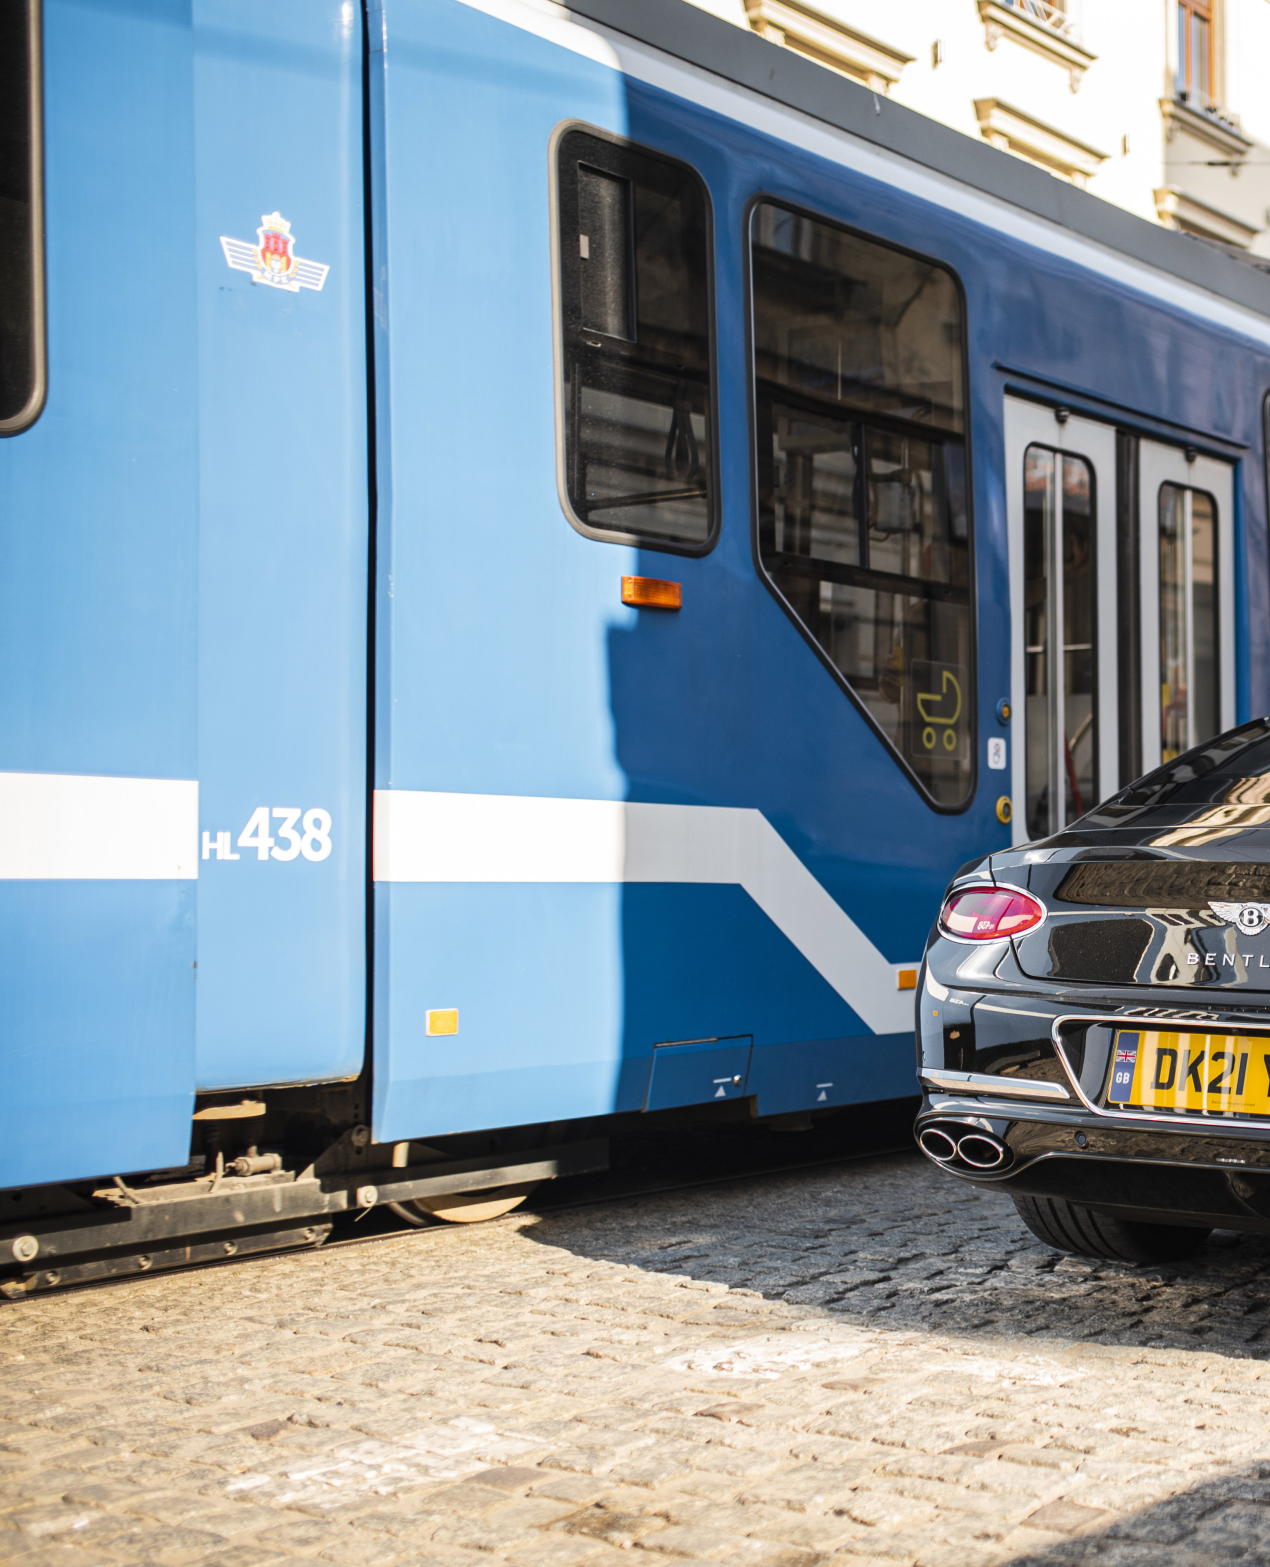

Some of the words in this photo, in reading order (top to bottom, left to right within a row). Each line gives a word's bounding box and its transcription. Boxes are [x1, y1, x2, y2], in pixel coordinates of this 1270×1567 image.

[1243, 908, 1260, 927] B
[1115, 1072, 1130, 1084] GB
[1150, 1048, 1248, 1096] DK21
